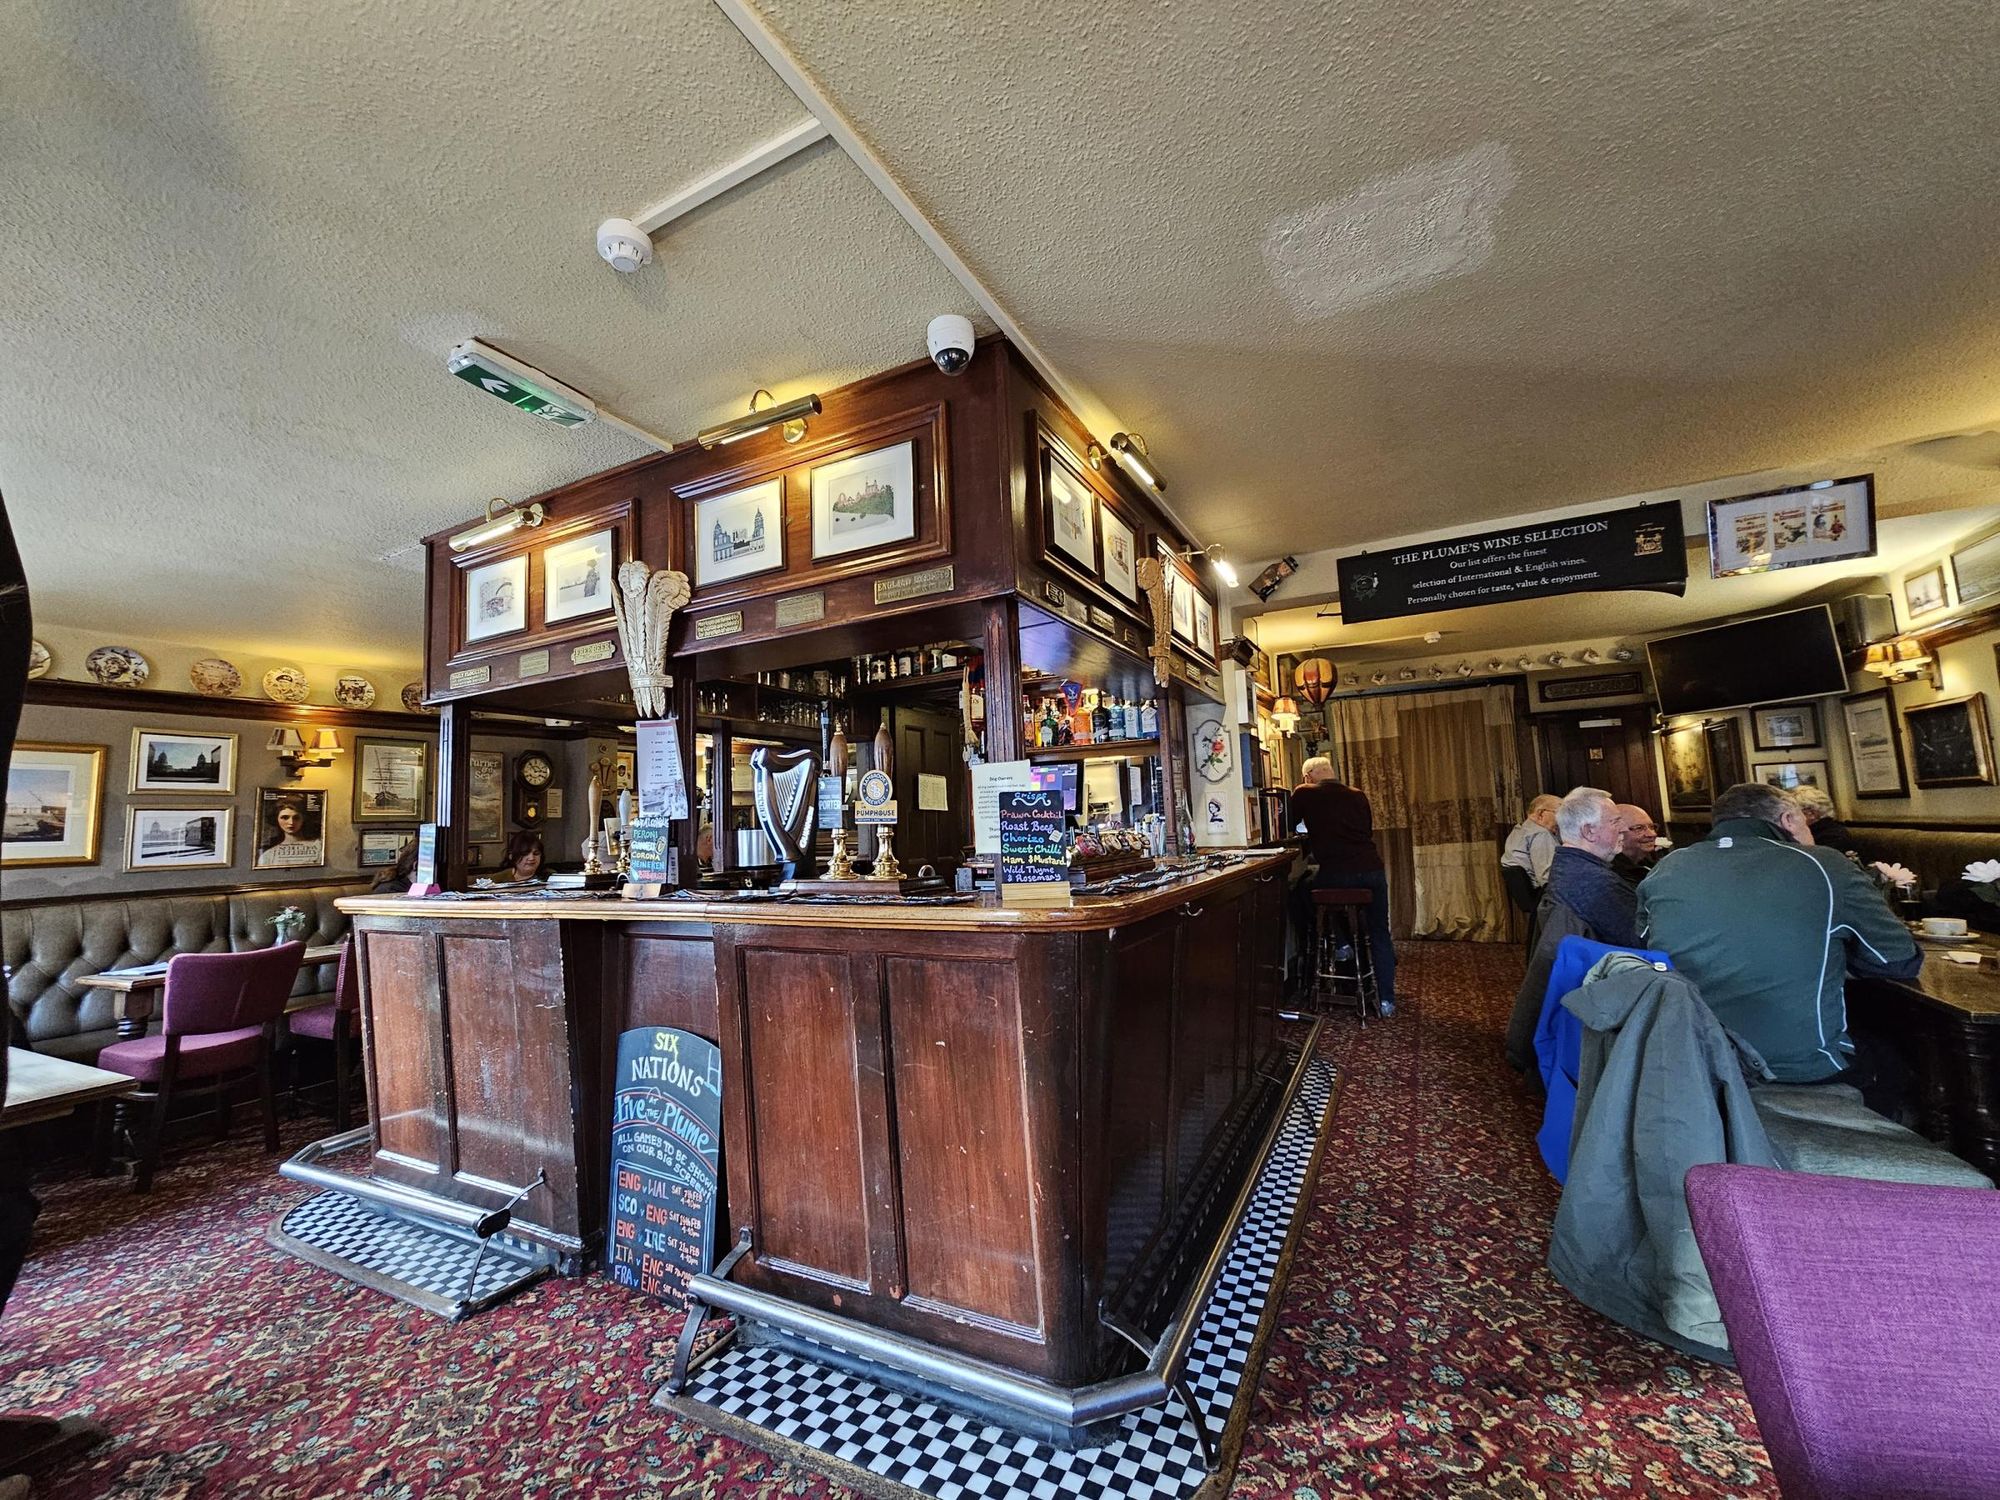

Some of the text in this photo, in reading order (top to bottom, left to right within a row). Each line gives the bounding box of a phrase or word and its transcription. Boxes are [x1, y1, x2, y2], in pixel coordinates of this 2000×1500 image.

[1392, 520, 1609, 566] THE PLUME'S WINE SELECTION
[1450, 561, 1467, 569] Our
[1482, 554, 1506, 564] offers
[1508, 551, 1521, 560] the
[1523, 548, 1548, 558] finest
[1412, 579, 1446, 589] selection
[1448, 576, 1458, 584] of
[1458, 568, 1512, 583] International
[1525, 561, 1558, 572] English
[1560, 556, 1588, 566] wines.
[1407, 572, 1600, 605] Personally chosen for taste, value & enjoyment.
[1000, 809, 1064, 818] Prawn Cocktail
[633, 830, 658, 839] PERONI
[1001, 820, 1054, 834] Roast Beef
[1002, 832, 1044, 843] Chorizo
[631, 852, 660, 860] CORONA
[1002, 844, 1062, 854] Sweet Chilli
[1002, 856, 1025, 864] Ham
[1034, 855, 1067, 865] Mustard
[631, 860, 665, 870] HEINEKEN
[1003, 865, 1054, 875] Wild Thyme
[1016, 874, 1061, 882] Rosemary
[654, 1032, 680, 1052] SIX
[632, 1056, 704, 1096] NATIONS
[646, 1108, 660, 1118] THE
[662, 1102, 717, 1153] Plume
[617, 1132, 718, 1194] ALL GAMES TO BE SHOWN
[622, 1144, 634, 1153] ON
[636, 1144, 655, 1157] OUR
[656, 1151, 672, 1167] BIG
[619, 1171, 641, 1191] ENG
[648, 1178, 669, 1200] WAL
[671, 1185, 681, 1195] SAT
[692, 1191, 703, 1202] FEB
[618, 1194, 637, 1215] SCO
[646, 1204, 668, 1225] ENG
[669, 1210, 679, 1222] SAT
[690, 1218, 701, 1230] FEB
[616, 1220, 635, 1240] ENG
[644, 1228, 666, 1253] IRE
[667, 1236, 677, 1248] SAT
[689, 1245, 700, 1257] FEB
[615, 1243, 634, 1264] ITA
[642, 1253, 664, 1277] ENG
[665, 1264, 674, 1273] SAT
[614, 1265, 633, 1285] FRA
[641, 1273, 660, 1296] ENG
[663, 1284, 672, 1294] SAT
